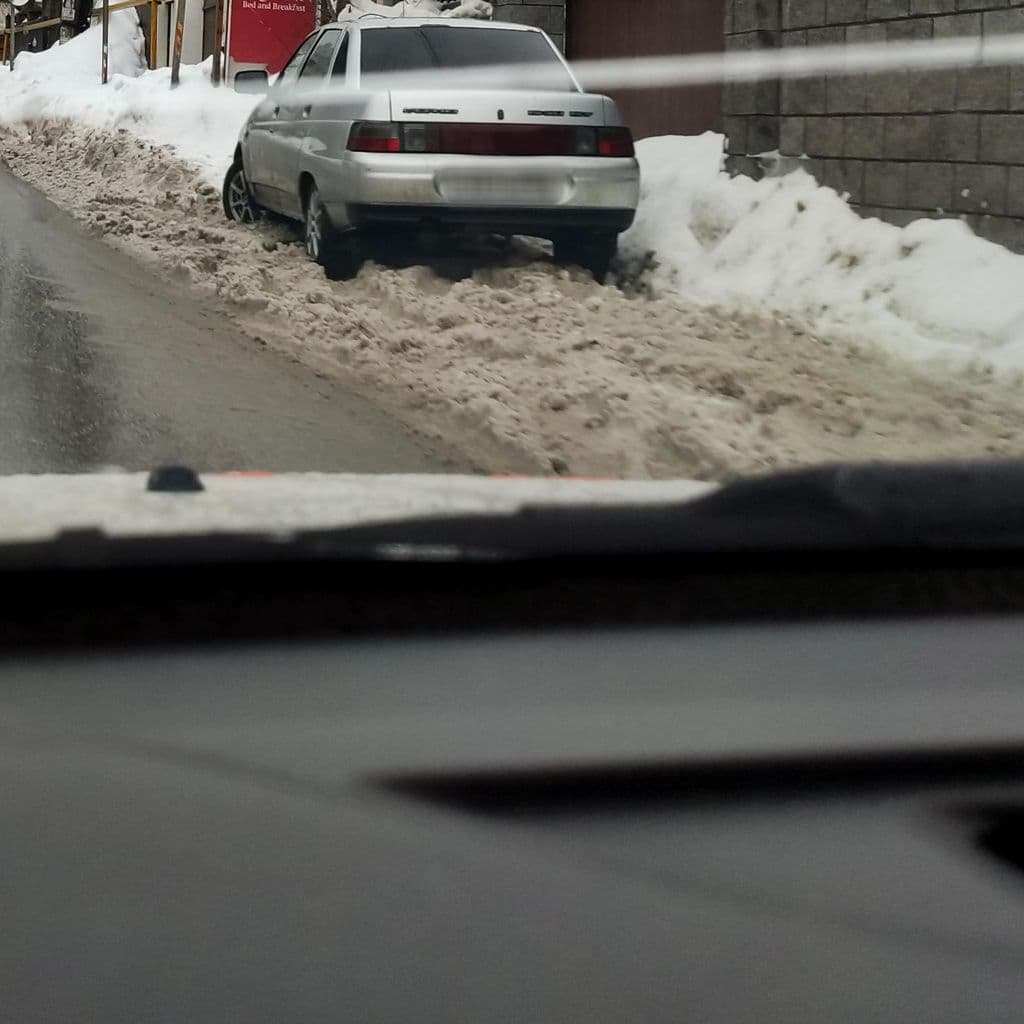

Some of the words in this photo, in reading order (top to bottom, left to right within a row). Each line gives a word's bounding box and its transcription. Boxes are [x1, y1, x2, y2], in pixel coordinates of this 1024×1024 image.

[242, 0, 256, 9] Bed
[257, 1, 271, 10] and
[272, 2, 306, 12] Breakfast
